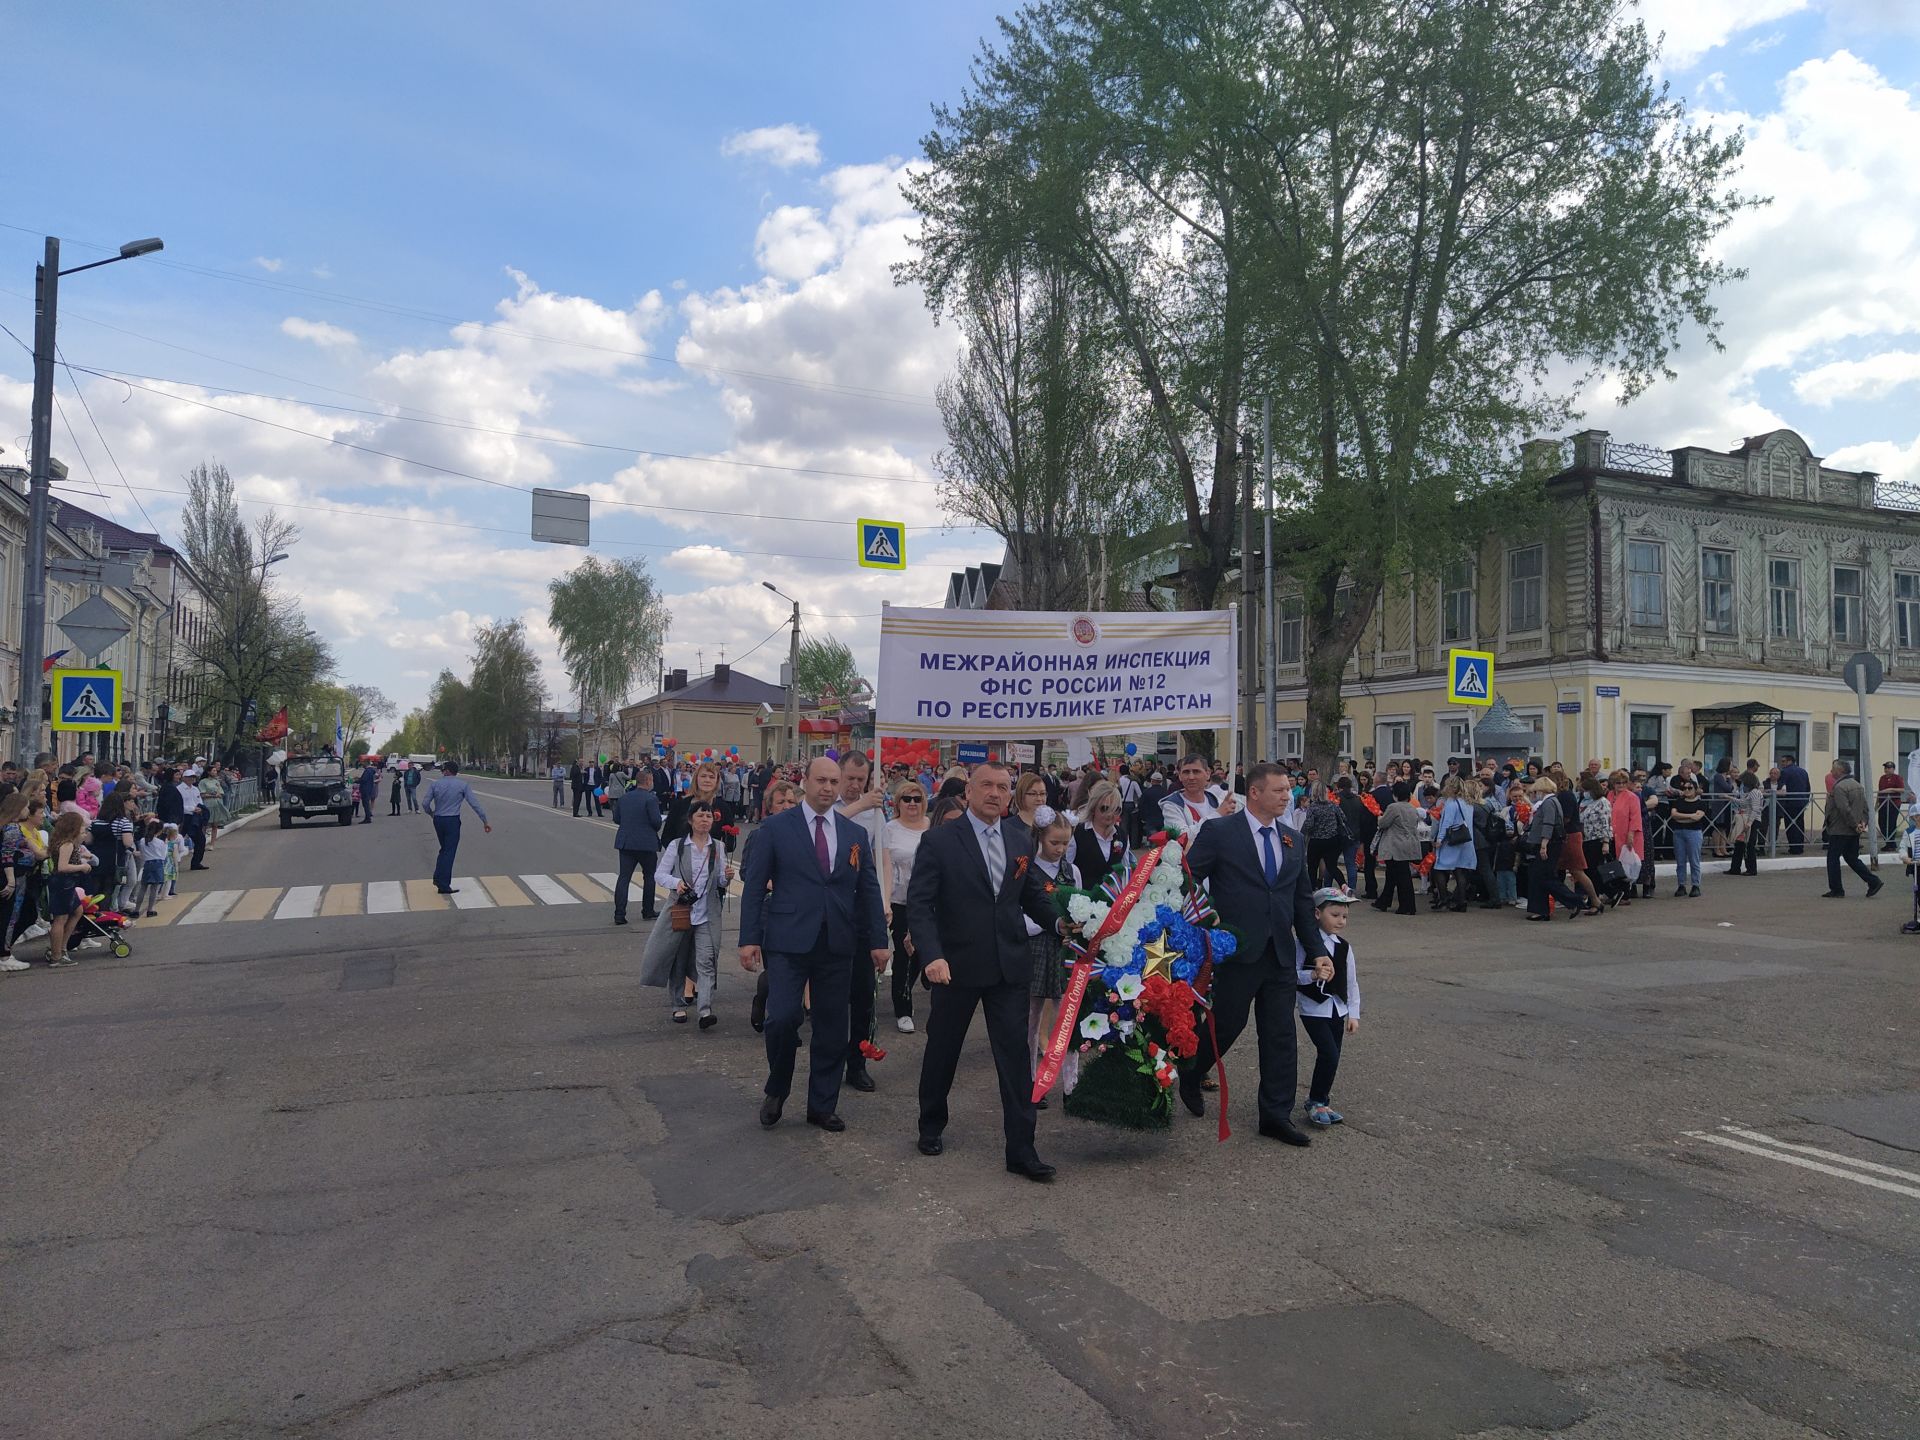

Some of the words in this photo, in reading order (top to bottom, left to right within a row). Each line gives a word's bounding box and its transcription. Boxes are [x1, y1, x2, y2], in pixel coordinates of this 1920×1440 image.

[920, 651, 1098, 672] МЕЖРАЙОННАЯ
[1105, 650, 1211, 670] ИНСПЕКЦИЯ
[980, 678, 1032, 695] ФНС
[1042, 675, 1122, 695] РОССИИ
[1129, 673, 1166, 691] №12
[917, 700, 951, 718] ПО
[962, 699, 1106, 719] РЕСПУБЛИКЕ
[1112, 693, 1212, 714] ТАТАРСТАН
[1048, 1003, 1076, 1061] Советского
[1068, 968, 1087, 1001] Союза
